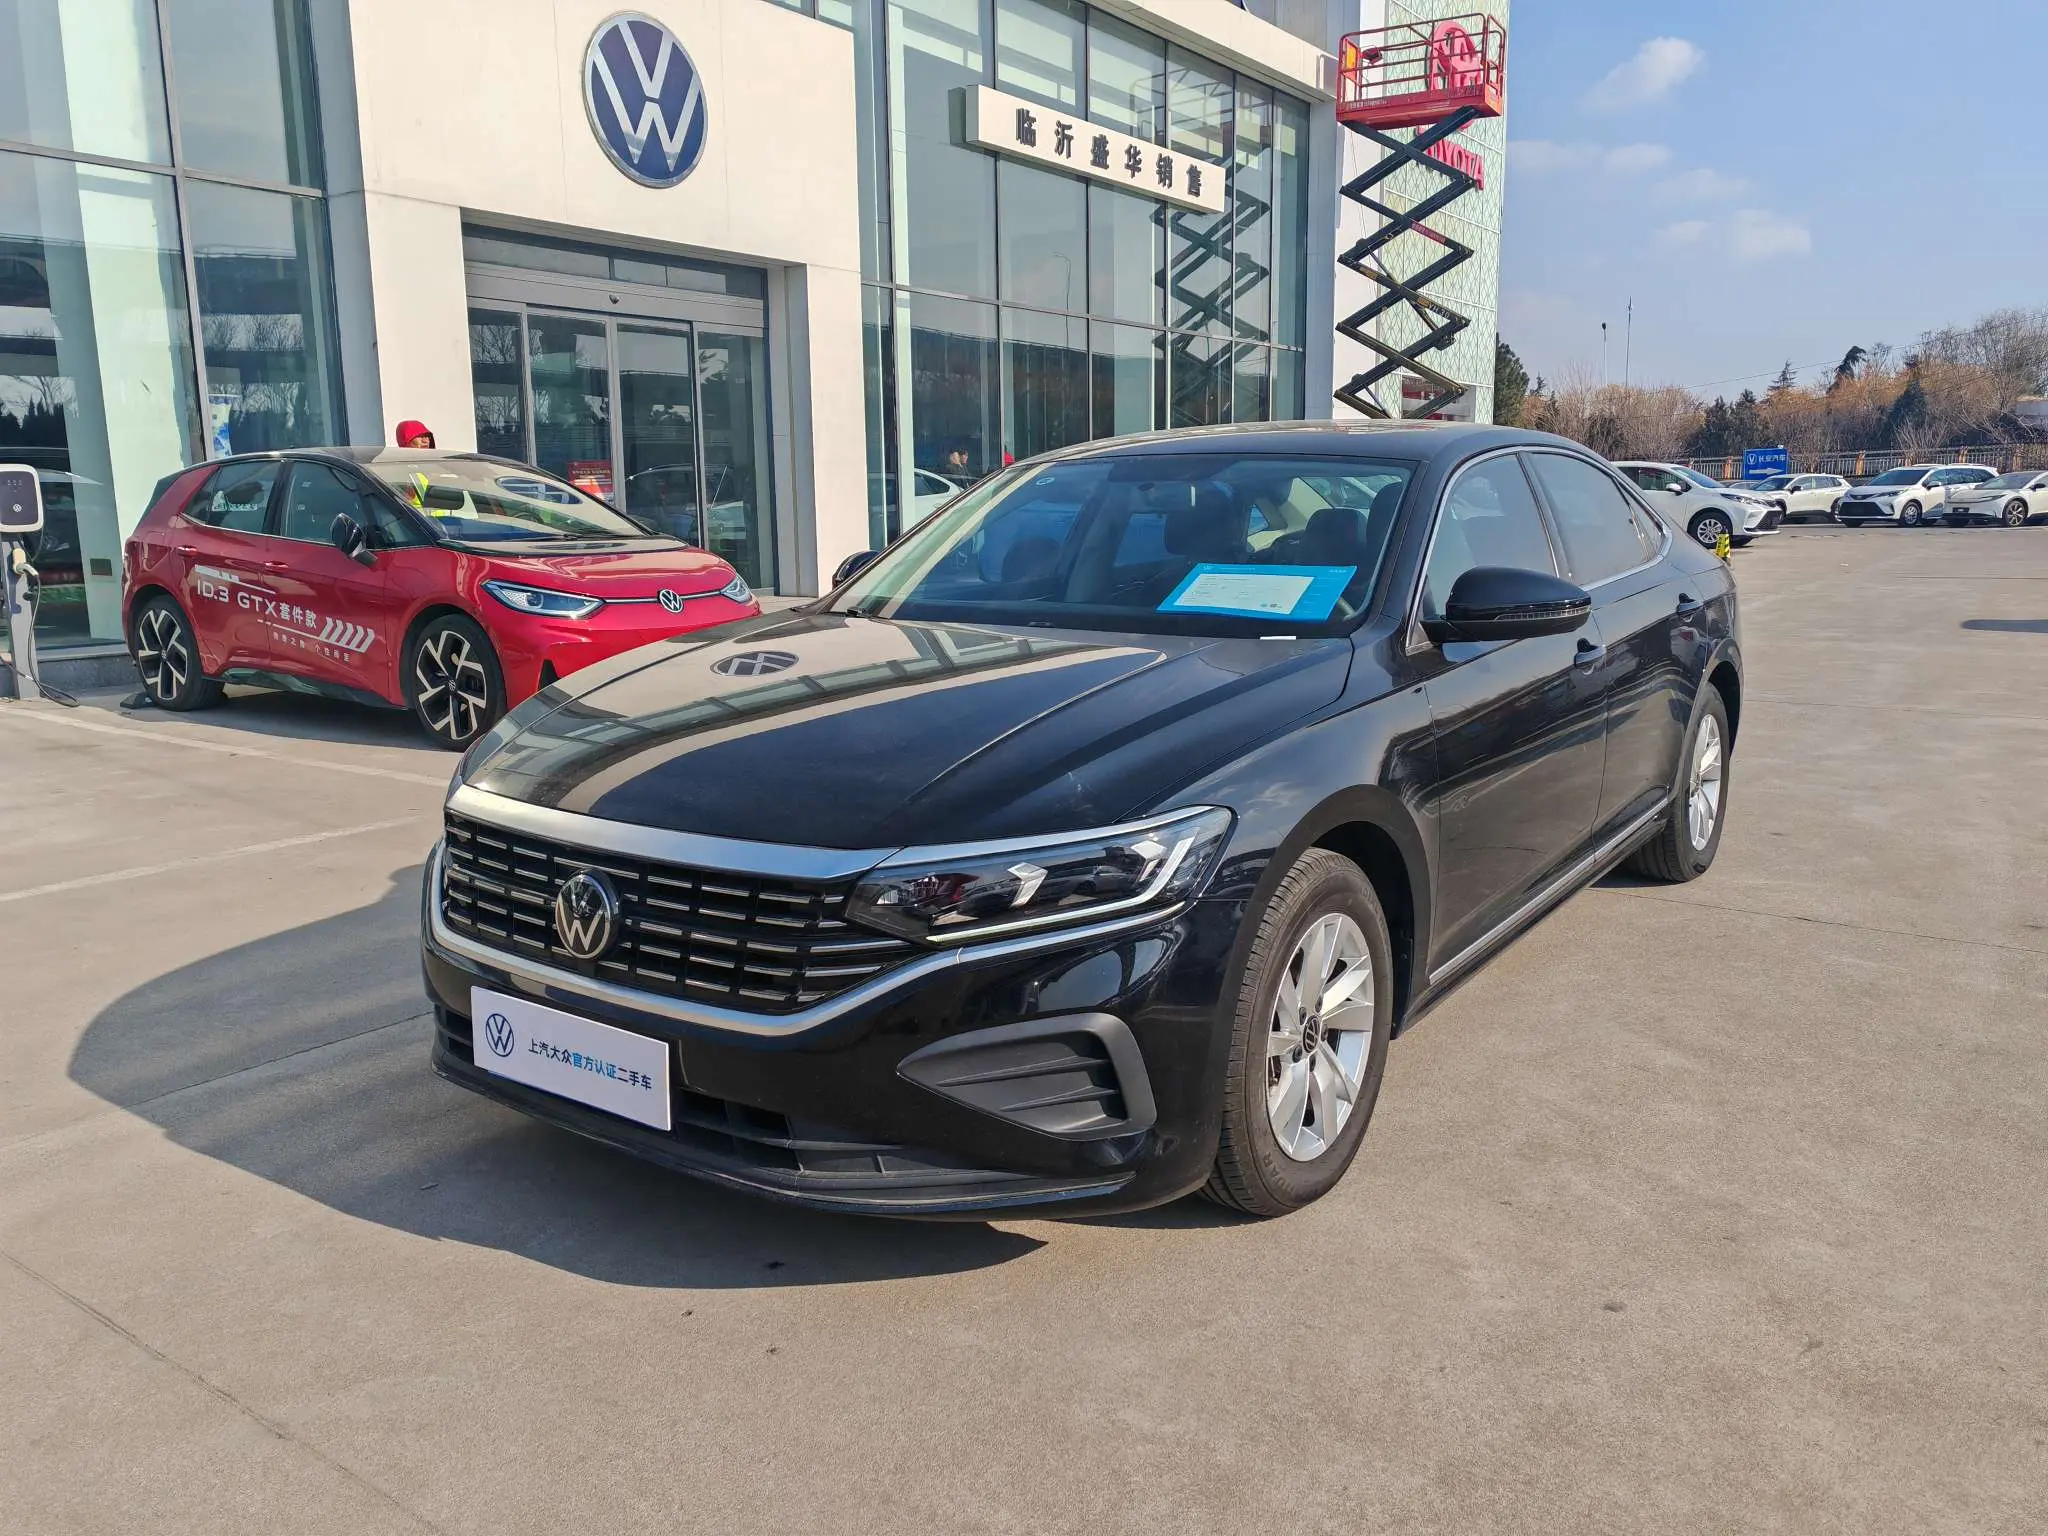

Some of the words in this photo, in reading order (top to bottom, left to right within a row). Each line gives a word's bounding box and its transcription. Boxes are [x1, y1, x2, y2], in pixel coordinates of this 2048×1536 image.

[1015, 107, 1202, 197] 临沂盛华销售
[197, 579, 229, 603] ID.3
[528, 1038, 652, 1090] 上汽大众官方认证二手车
